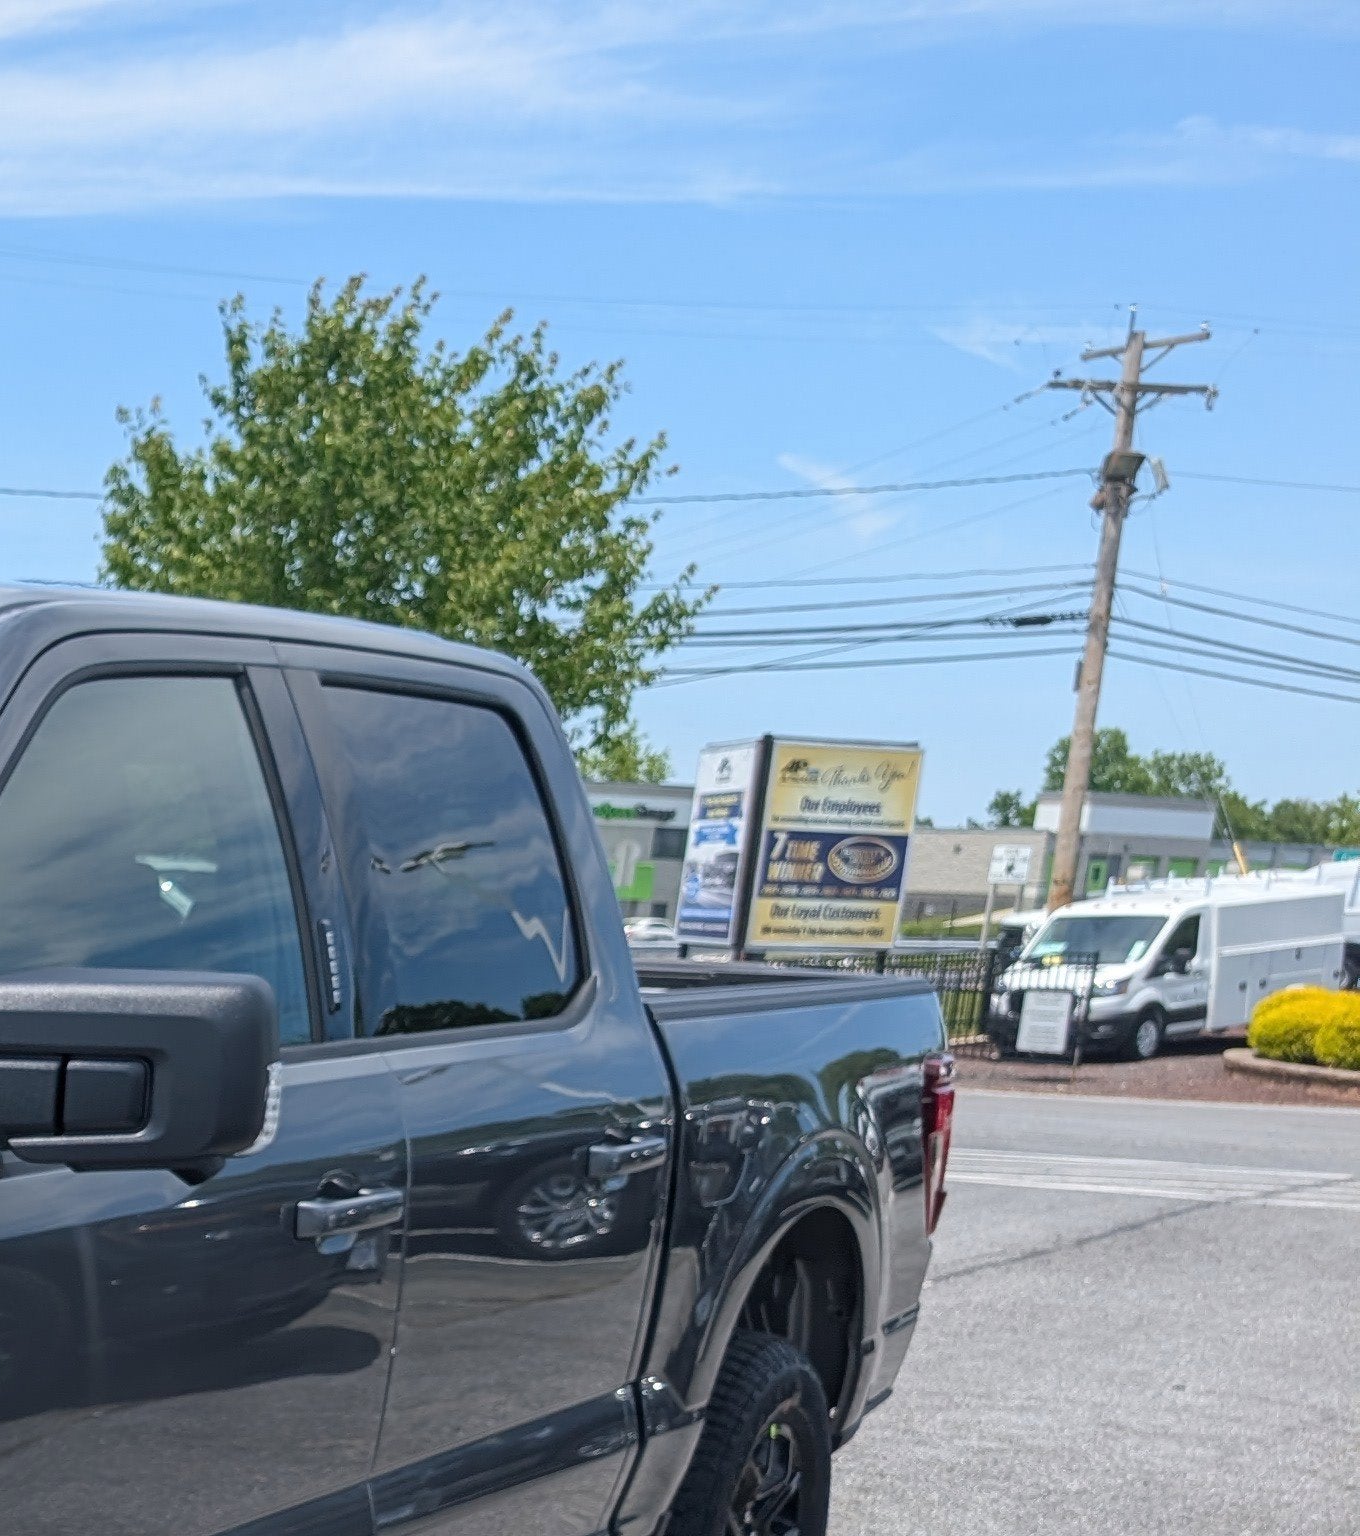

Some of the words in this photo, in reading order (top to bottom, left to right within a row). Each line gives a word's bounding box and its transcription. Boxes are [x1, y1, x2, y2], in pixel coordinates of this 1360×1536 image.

[799, 794, 818, 813] Our
[822, 796, 881, 816] Employees
[770, 832, 789, 860] 7
[785, 840, 821, 862] TIME
[767, 861, 825, 884] WINNER
[770, 903, 791, 918] Our
[790, 904, 821, 920] Loyal
[822, 905, 880, 921] Customers
